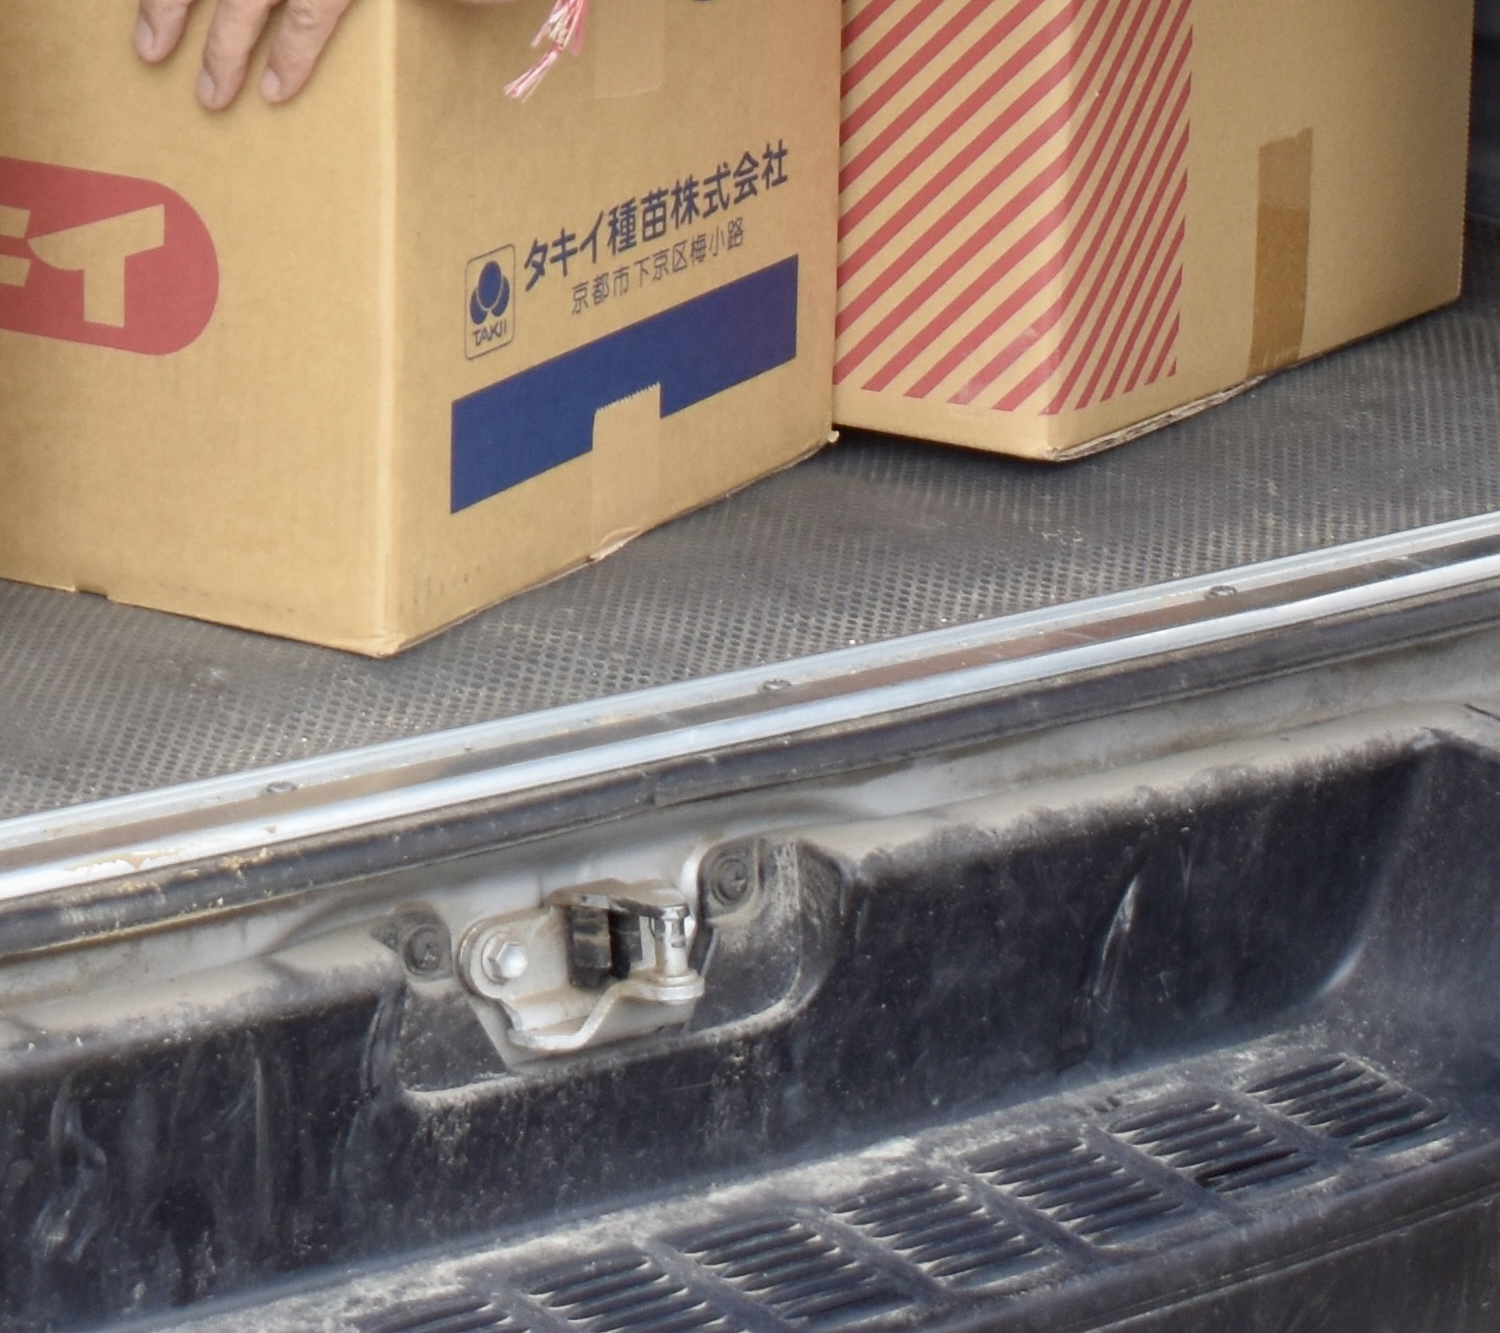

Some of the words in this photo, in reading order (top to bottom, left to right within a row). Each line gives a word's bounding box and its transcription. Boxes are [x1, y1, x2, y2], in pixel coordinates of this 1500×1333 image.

[523, 139, 789, 291] タキイ種苗株式会社
[571, 217, 745, 315] 京都市下京区梅小路
[472, 320, 508, 346] TAKII
